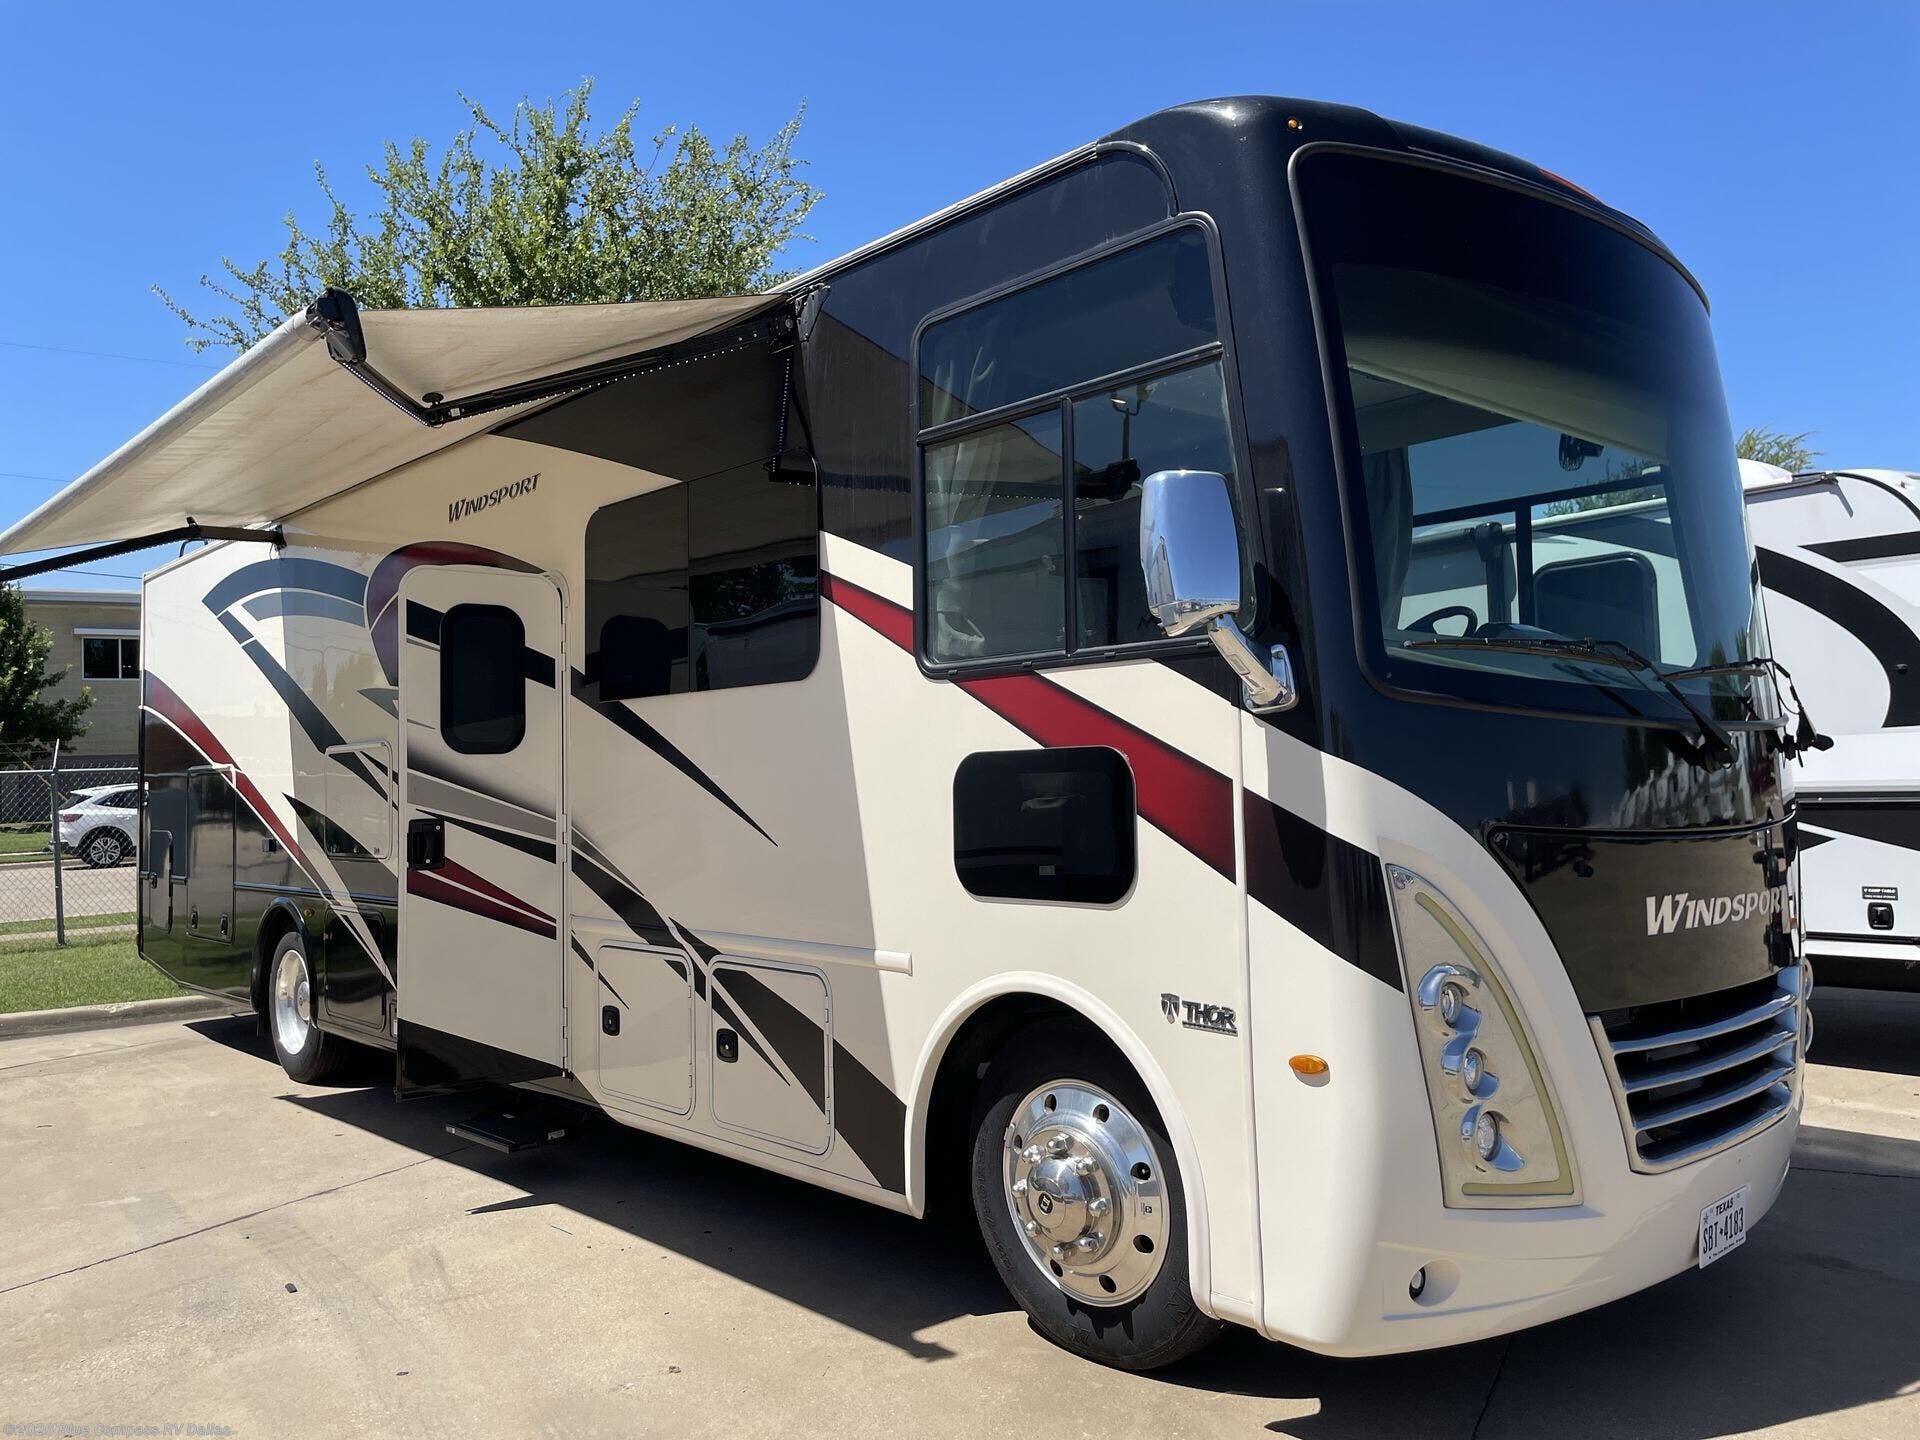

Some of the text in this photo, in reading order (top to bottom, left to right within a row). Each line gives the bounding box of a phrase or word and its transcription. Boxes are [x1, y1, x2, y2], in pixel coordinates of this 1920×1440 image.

[448, 472, 541, 523] WINDSPORT
[1181, 1000, 1238, 1030] THOR
[1715, 1198, 1734, 1216] TEXAS
